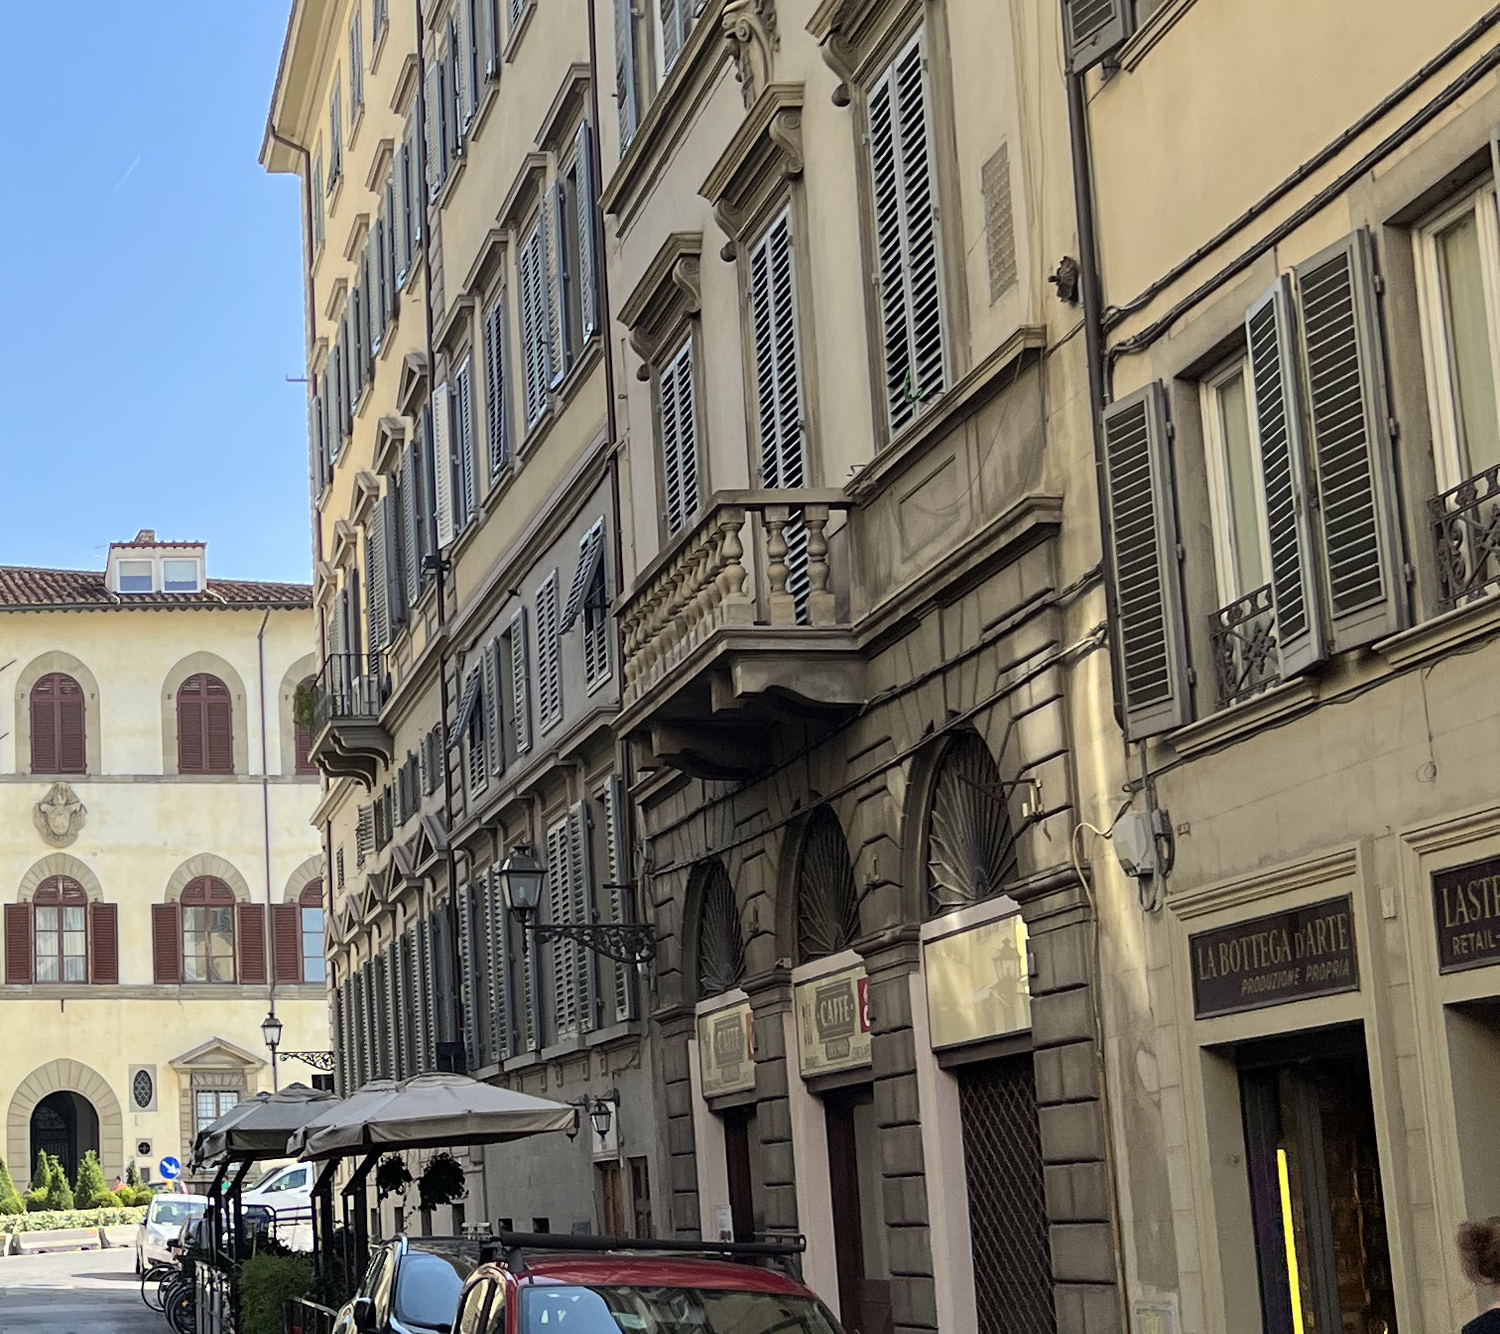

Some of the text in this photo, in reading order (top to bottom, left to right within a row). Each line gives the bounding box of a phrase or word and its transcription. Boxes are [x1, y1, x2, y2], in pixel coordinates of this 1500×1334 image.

[1197, 946, 1217, 980] LA
[1219, 928, 1292, 975] BOTTEGA
[1452, 929, 1496, 956] RETAIL
[1241, 958, 1350, 996] PRODUZIONE PROPRIA
